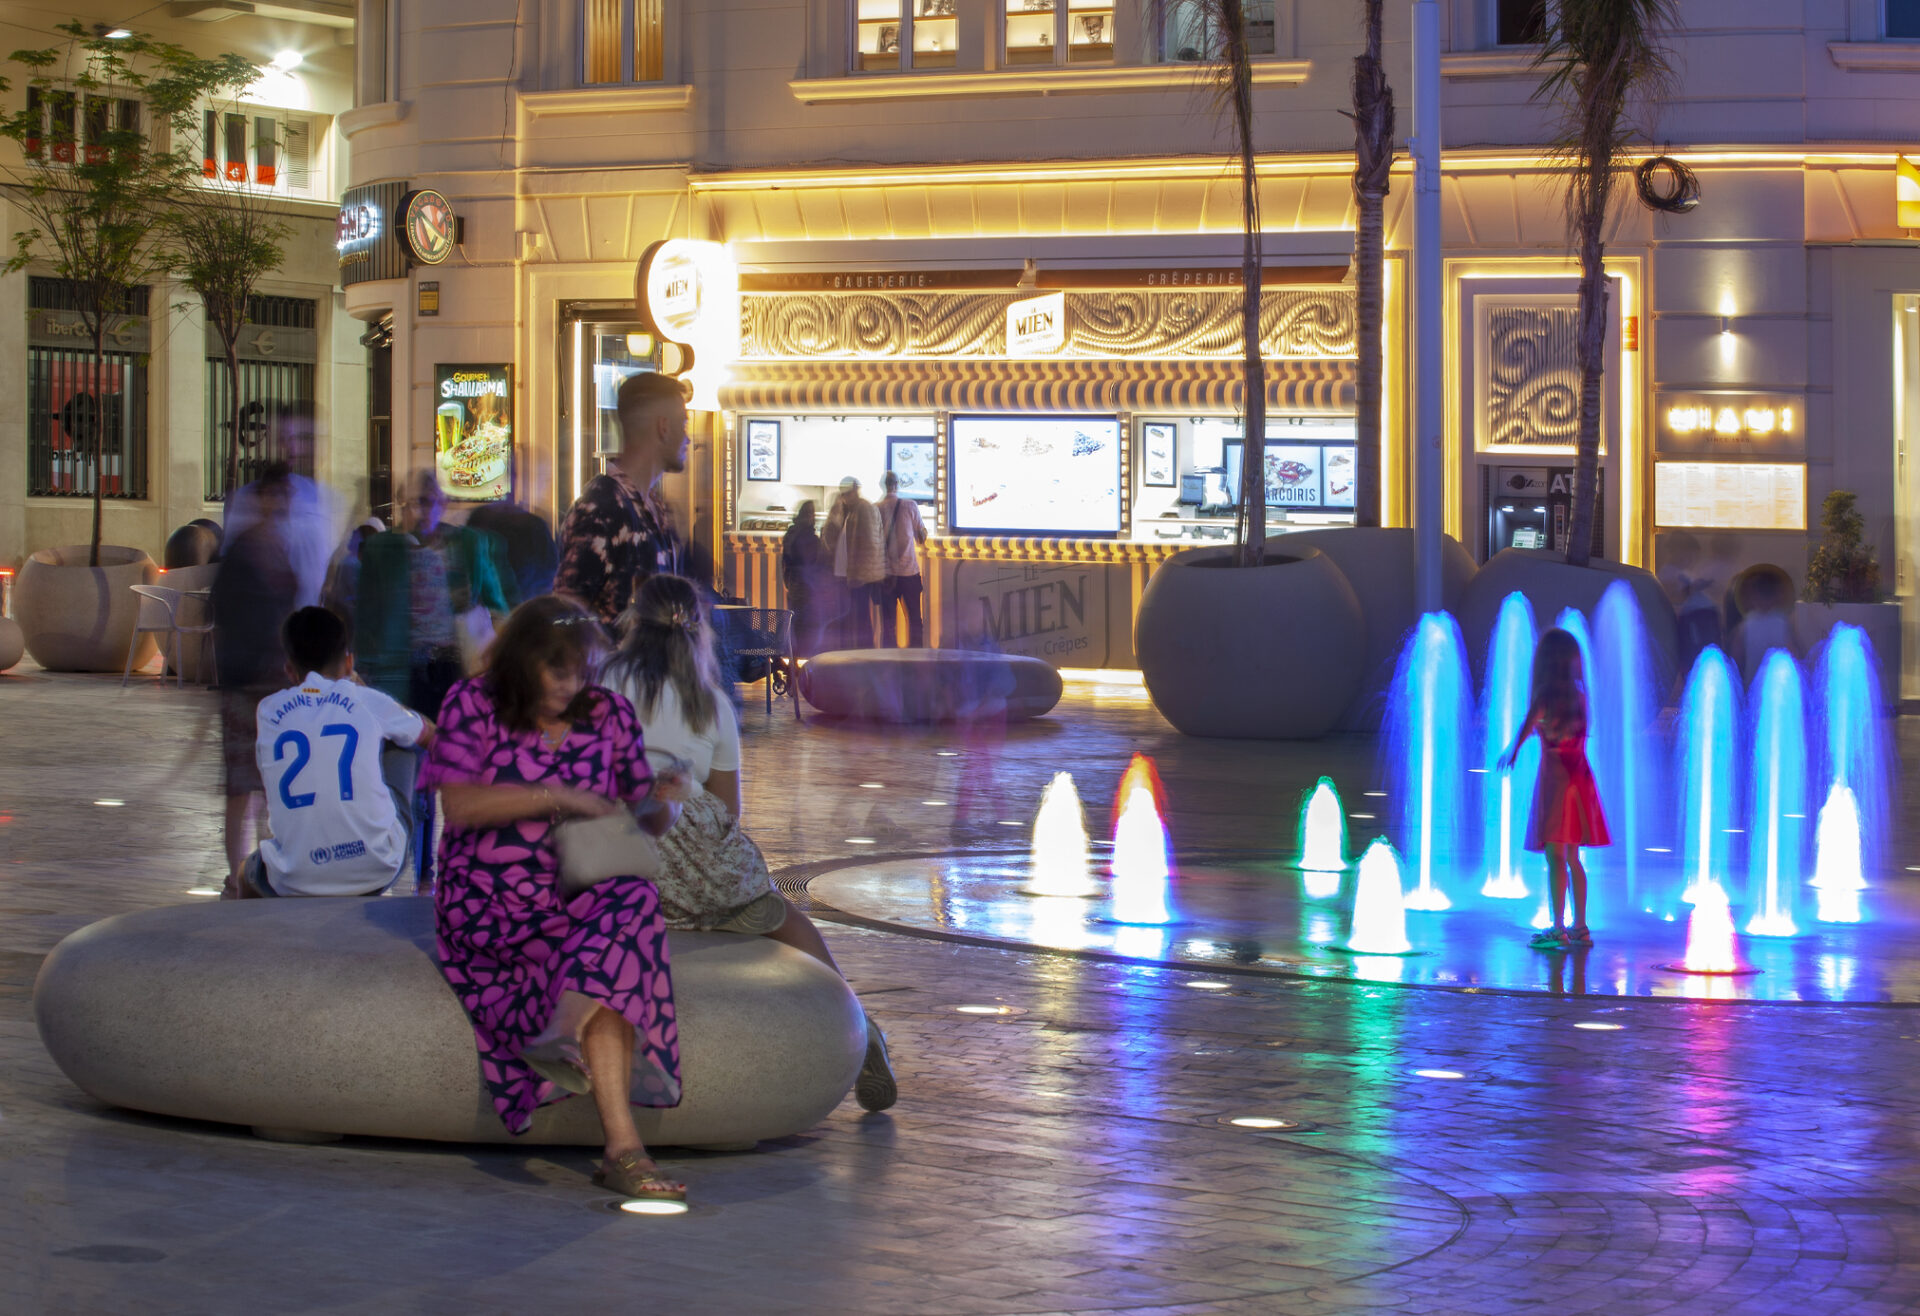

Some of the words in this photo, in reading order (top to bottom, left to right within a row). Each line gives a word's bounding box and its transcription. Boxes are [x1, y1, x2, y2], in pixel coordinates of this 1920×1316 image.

[834, 275, 925, 288] GAUFRERIE
[1148, 271, 1235, 285] CRÊPERIE
[47, 319, 98, 342] iberCa
[1015, 311, 1053, 336] MIEN
[441, 379, 506, 398] SHAWARMA
[1265, 488, 1316, 502] ARCOIRIS
[1024, 564, 1039, 582] LE
[978, 575, 1087, 642] MIEN
[1044, 636, 1088, 656] Crêpes
[270, 694, 313, 725] LAMINE
[273, 724, 359, 810] 27
[331, 840, 365, 852] UNHCR
